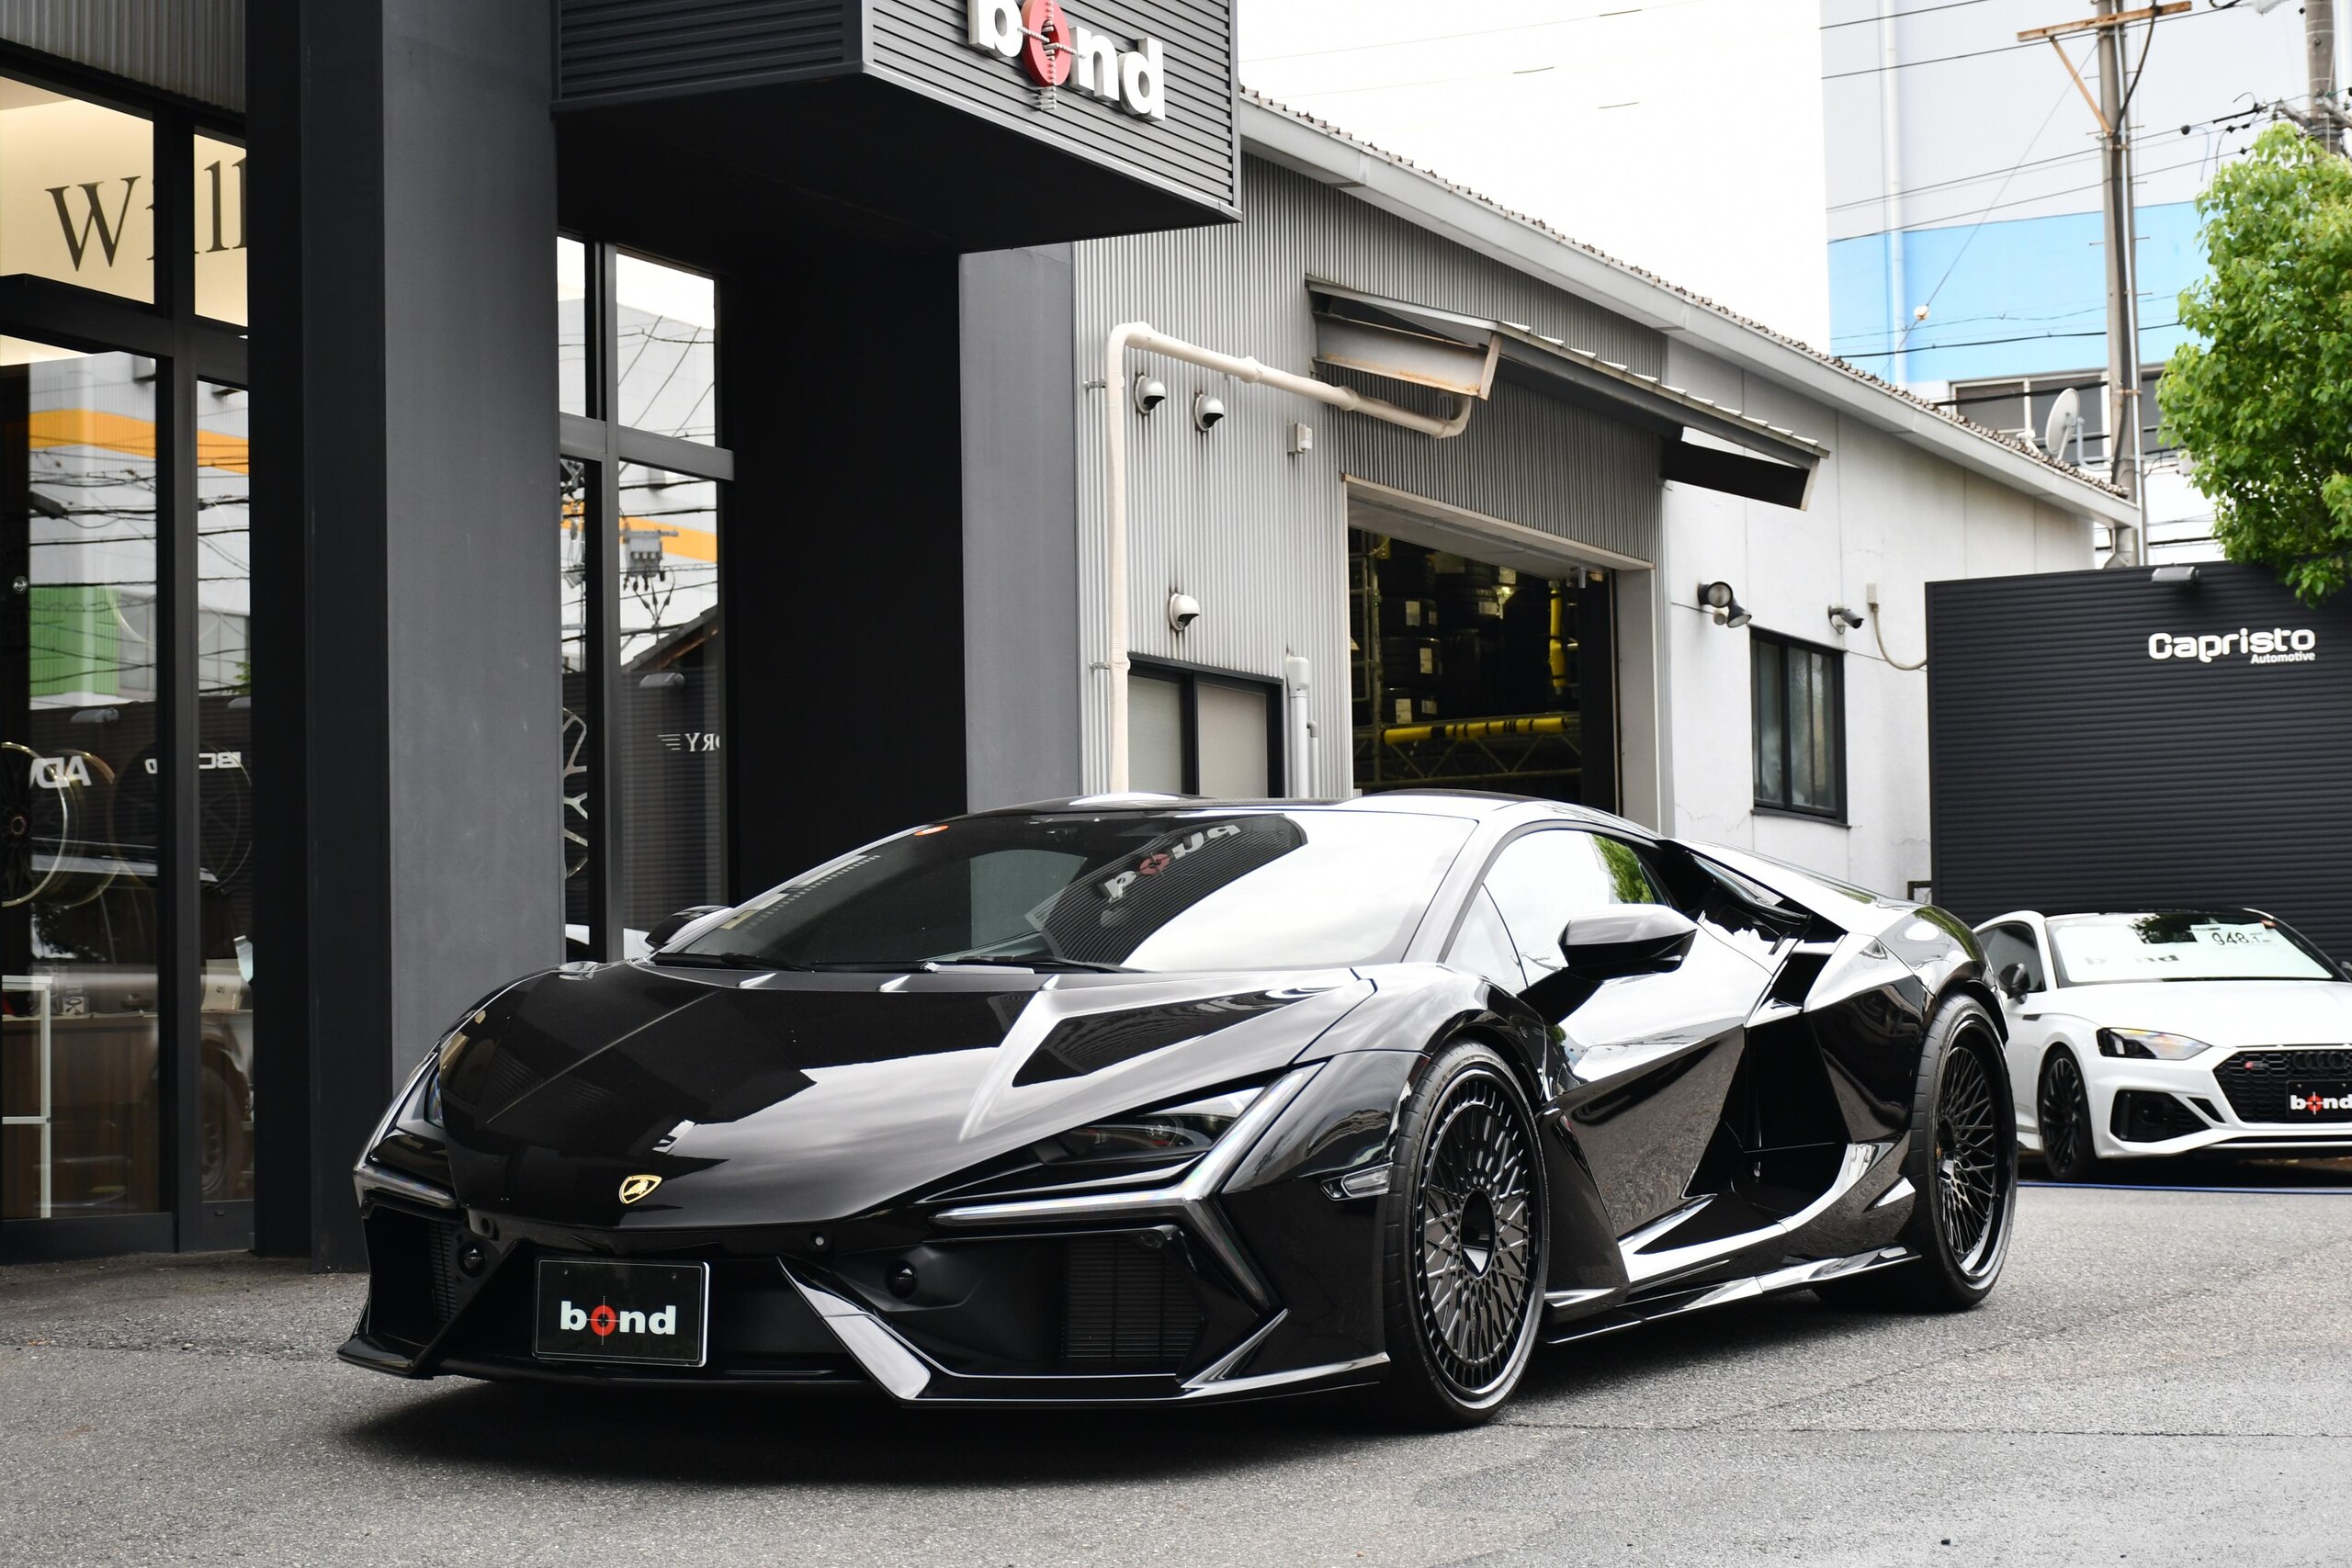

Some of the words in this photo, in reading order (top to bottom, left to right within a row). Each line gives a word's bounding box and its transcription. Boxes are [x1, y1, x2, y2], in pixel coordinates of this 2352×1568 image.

[967, 0, 1166, 121] bond
[44, 156, 247, 272] Wll
[2148, 627, 2316, 663] Capristo
[2250, 651, 2316, 665] Automotive
[2290, 1093, 2352, 1112] bond
[560, 1300, 676, 1337] bond
